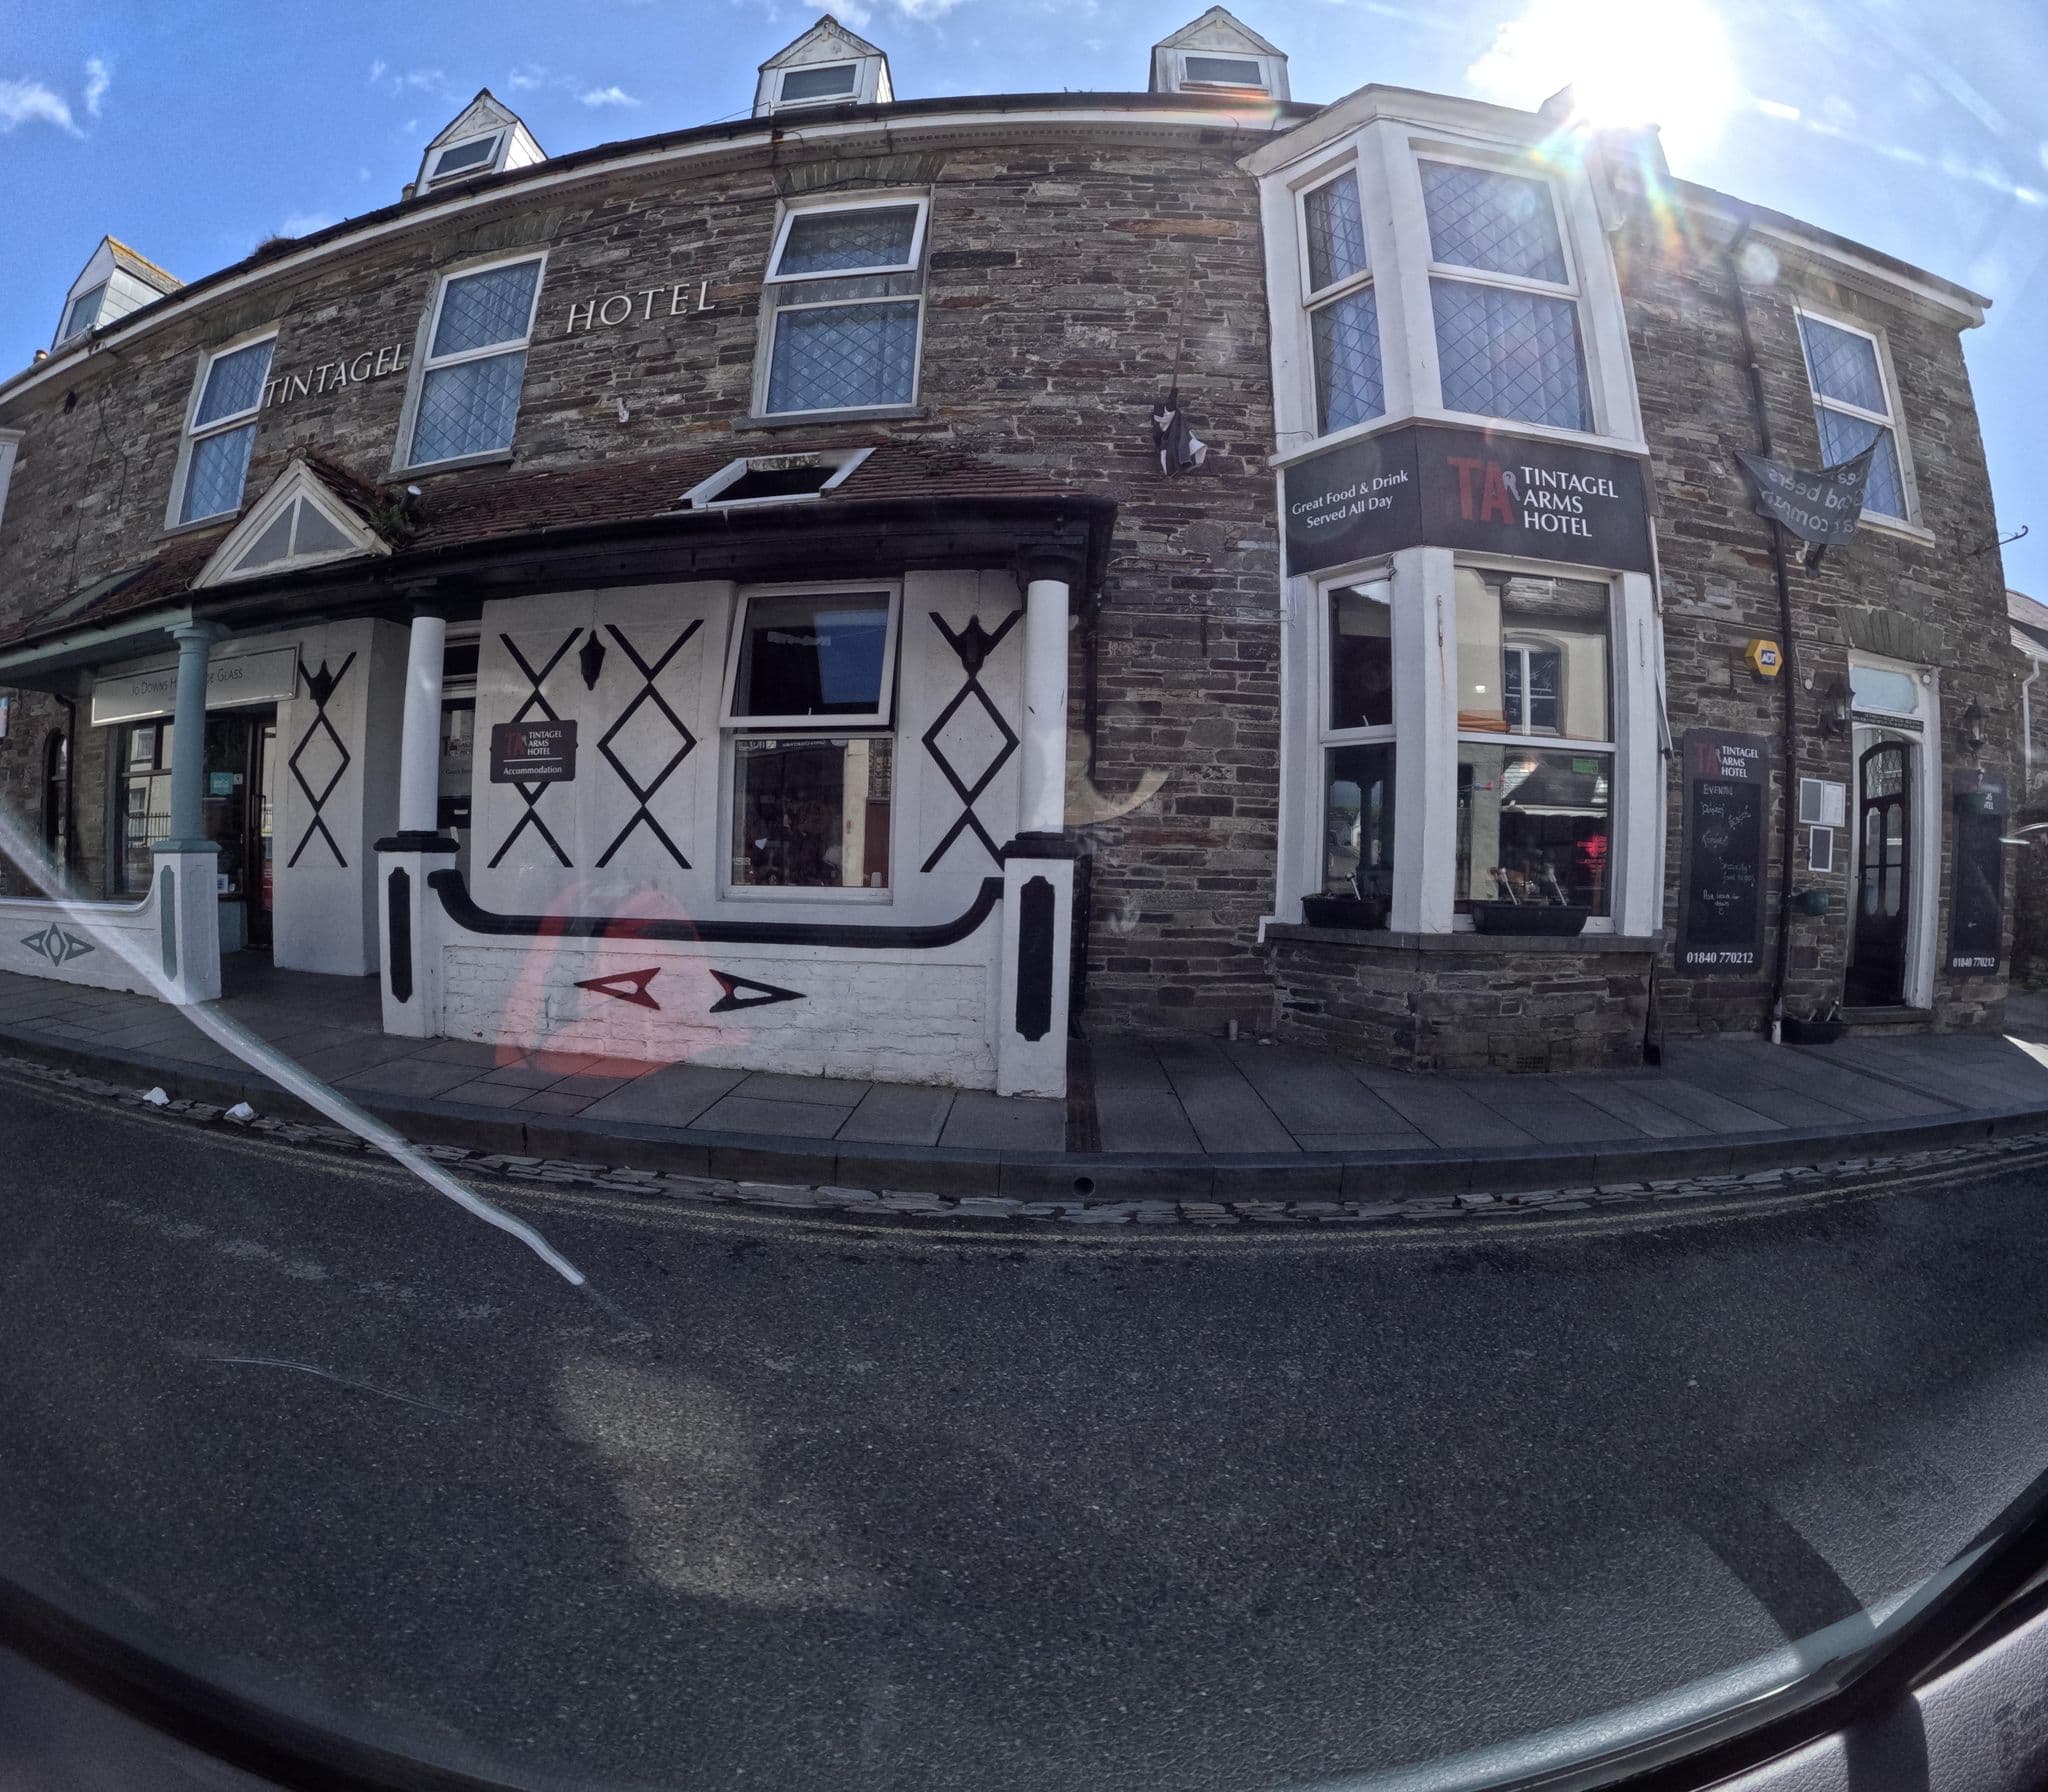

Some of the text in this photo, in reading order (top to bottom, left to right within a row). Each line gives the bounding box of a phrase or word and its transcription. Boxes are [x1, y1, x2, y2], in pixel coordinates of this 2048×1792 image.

[265, 280, 715, 408] TINTAGEL HOTEL
[1520, 466, 1619, 499] TINTAGEL
[1292, 469, 1408, 515] Great Food & Drink
[1447, 456, 1515, 525] TA
[1524, 489, 1583, 514] ARMS
[1306, 496, 1393, 528] Served All Day
[1524, 510, 1592, 537] HOTEL
[1760, 652, 1776, 664] ADT
[217, 667, 243, 683] GLASS
[529, 730, 562, 739] TINTAGEL
[528, 739, 549, 747] ARMS
[527, 747, 551, 756] HOTEL
[1721, 745, 1759, 759] TINTAGEL
[1721, 756, 1746, 768] ARMS
[503, 766, 562, 775] Accommodation
[1721, 766, 1748, 778] HOTEL
[1686, 952, 1753, 964] 01840 770212
[1952, 957, 1972, 967] 01840
